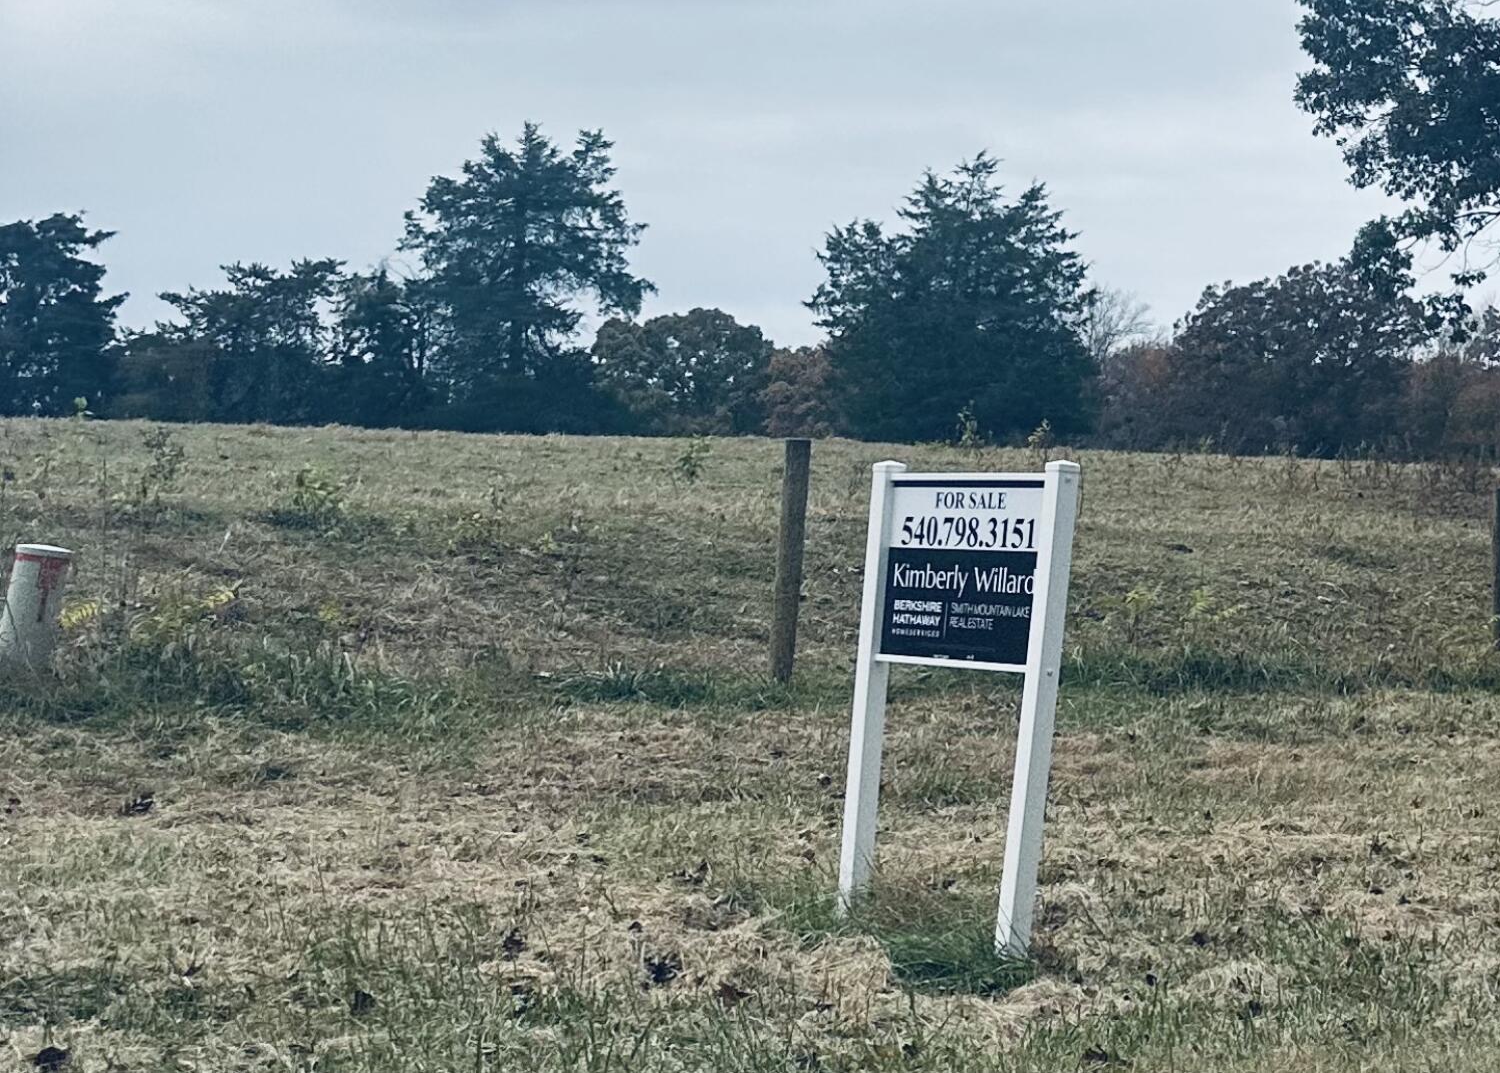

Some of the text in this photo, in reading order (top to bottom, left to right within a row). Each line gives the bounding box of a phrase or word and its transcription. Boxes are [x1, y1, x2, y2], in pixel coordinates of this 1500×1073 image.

[935, 492, 1006, 510] FOR SALE
[901, 516, 1035, 548] 540.798.3151
[893, 563, 969, 597] Kimberly
[894, 599, 943, 613] BERKSHIRE
[951, 602, 1030, 618] SMITH MOUNTAIN LAKE
[892, 613, 940, 626] HATHAWAY
[949, 616, 994, 630] REAL ESTATE
